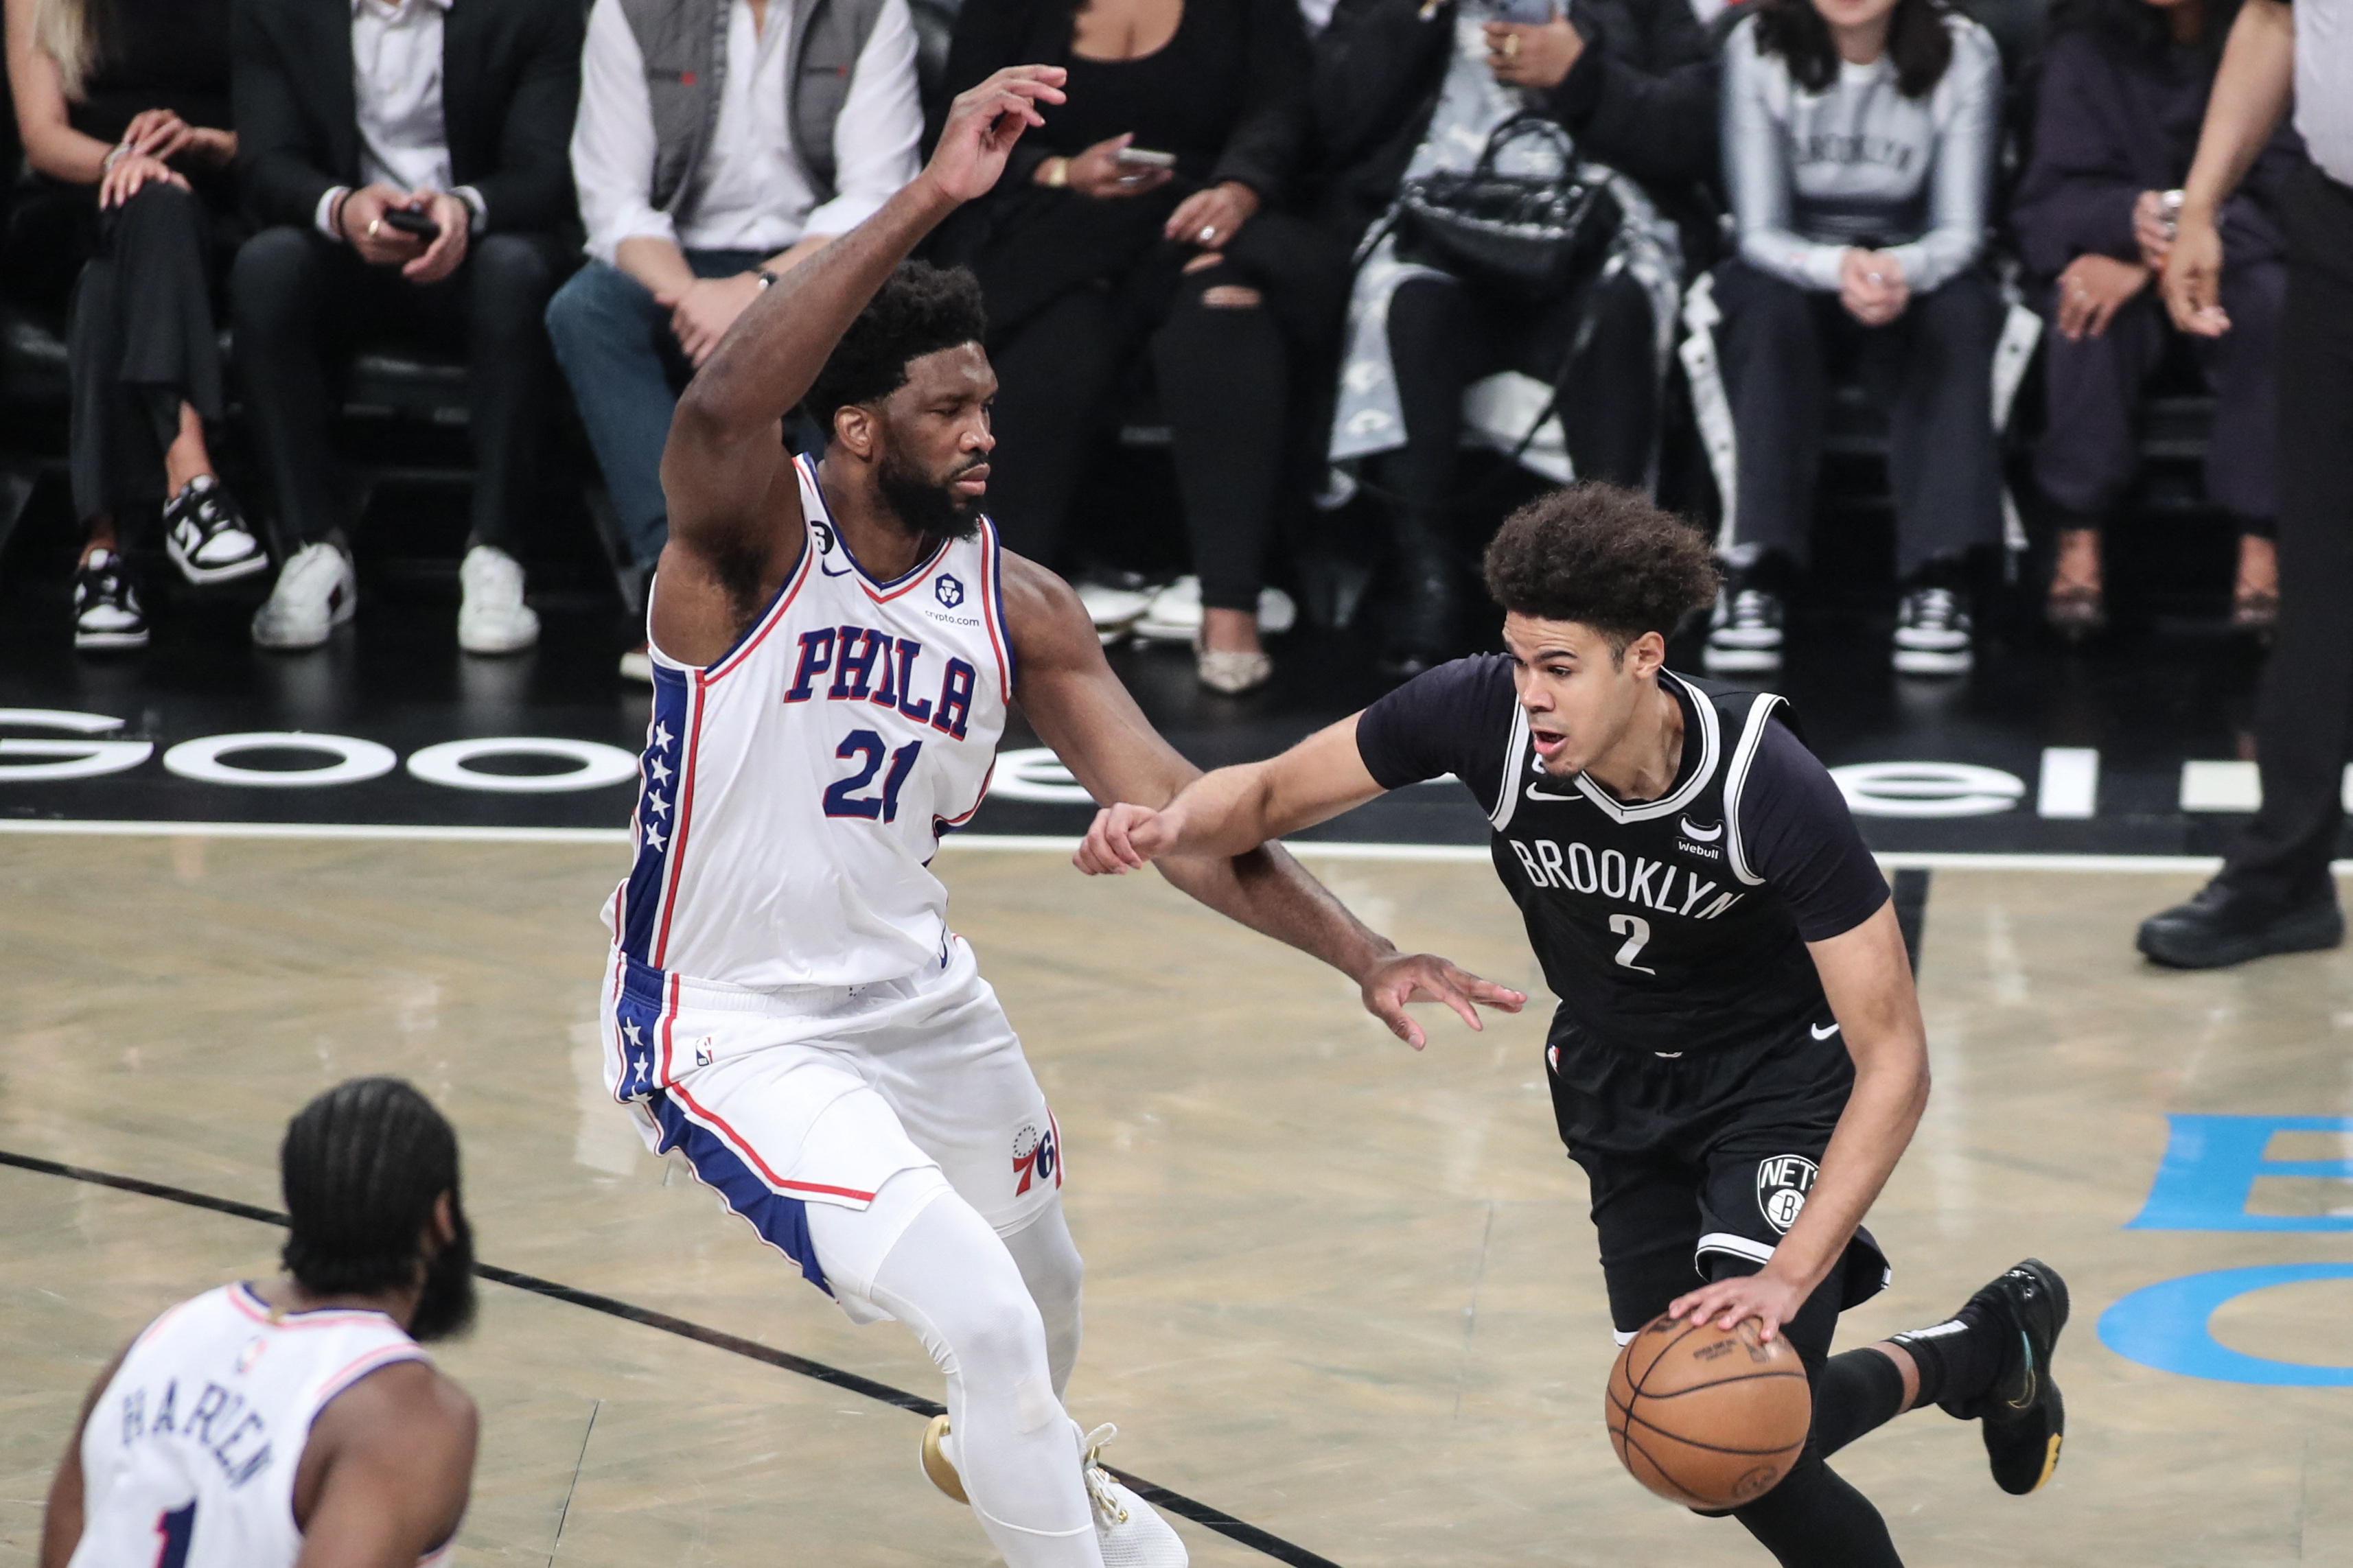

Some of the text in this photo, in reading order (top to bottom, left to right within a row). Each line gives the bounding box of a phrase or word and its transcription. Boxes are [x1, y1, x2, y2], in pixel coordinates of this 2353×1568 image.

[925, 610, 980, 627] crypto.com
[784, 625, 975, 742] PHILA
[824, 729, 923, 825] 21
[1509, 839, 1746, 920] BROOKLYN
[1678, 841, 1719, 860] Webull
[1608, 913, 1656, 976] 2
[1012, 1129, 1055, 1197] 76
[1780, 1194, 1796, 1223] B
